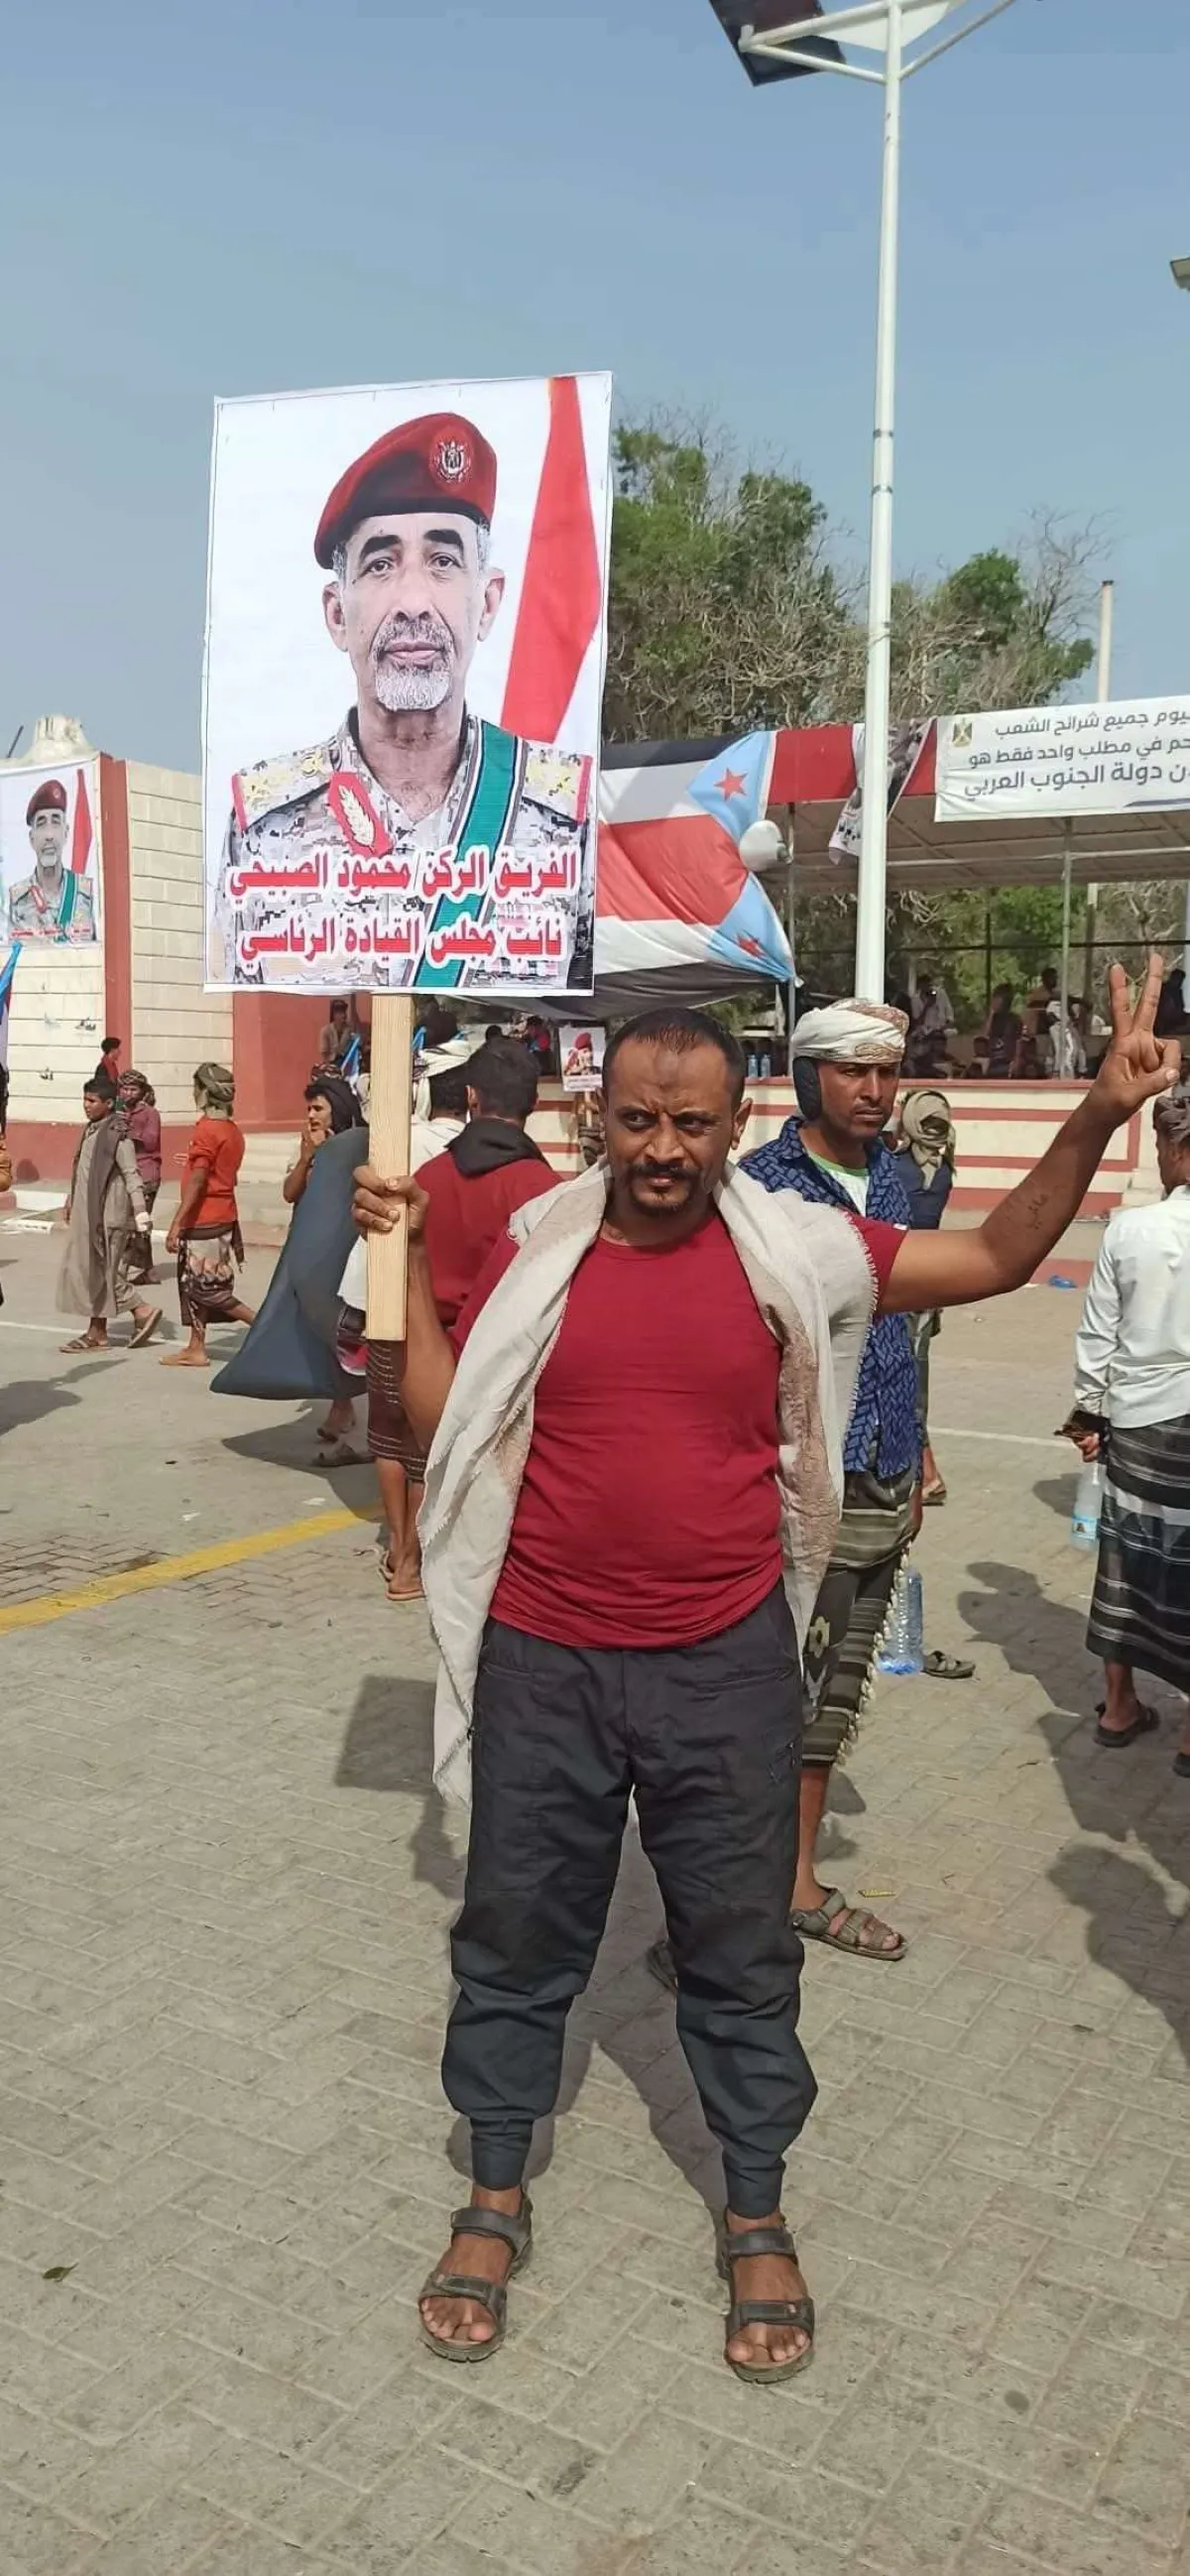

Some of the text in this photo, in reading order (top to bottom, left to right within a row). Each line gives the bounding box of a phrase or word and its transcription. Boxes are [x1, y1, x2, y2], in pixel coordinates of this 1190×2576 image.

[995, 710, 1190, 740] يوم جميع شرائح الشعب
[968, 751, 992, 769] هو
[996, 746, 1033, 764] فقط
[1036, 744, 1074, 761] واحد
[1078, 740, 1131, 761] مطلب
[1135, 735, 1162, 761] في
[964, 771, 1024, 801] العربي
[1031, 765, 1105, 792] الجنوب
[1112, 761, 1162, 786] دولة
[230, 852, 328, 905] الصبيحي
[338, 859, 412, 897] محمود
[495, 850, 576, 898] الفريق
[242, 914, 562, 968] نائب مجلس القيادة الرئاسي
